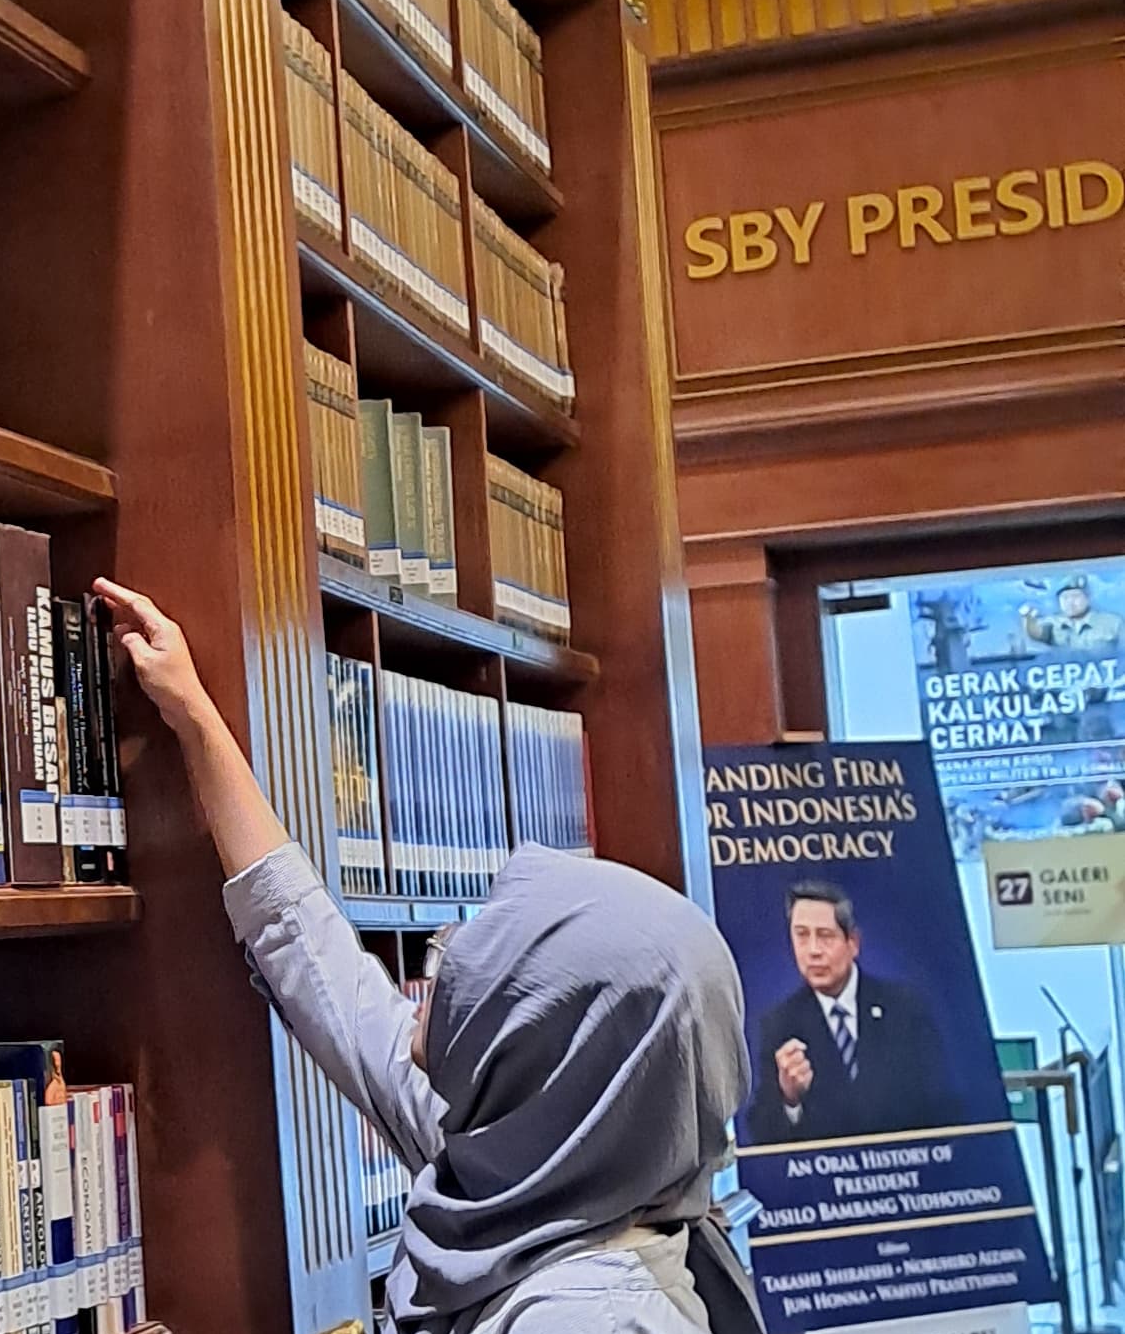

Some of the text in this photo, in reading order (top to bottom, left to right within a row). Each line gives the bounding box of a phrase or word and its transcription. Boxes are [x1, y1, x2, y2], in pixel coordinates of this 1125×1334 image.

[685, 202, 824, 279] SBY
[36, 586, 55, 698] KAMUS
[26, 606, 45, 781] ILMU PENGETAHUAN
[925, 658, 1118, 699] GERAK CEPAT
[927, 689, 1086, 725] KALKULASI
[930, 718, 1046, 750] CERMAT
[706, 761, 825, 793] ANDING
[832, 757, 905, 787] FIRM
[739, 788, 917, 827] INDONESIA'S
[710, 830, 894, 866] DEMOCRACY
[999, 878, 1029, 902] 27
[1039, 866, 1109, 884] GALERI
[1043, 889, 1085, 905] SENI
[815, 1153, 860, 1175] ORAL
[861, 1146, 930, 1169] HISTORY
[833, 1171, 920, 1196] PRESIDENT
[758, 1185, 1001, 1229] SUSILO BAMBANG YUDHOYONO
